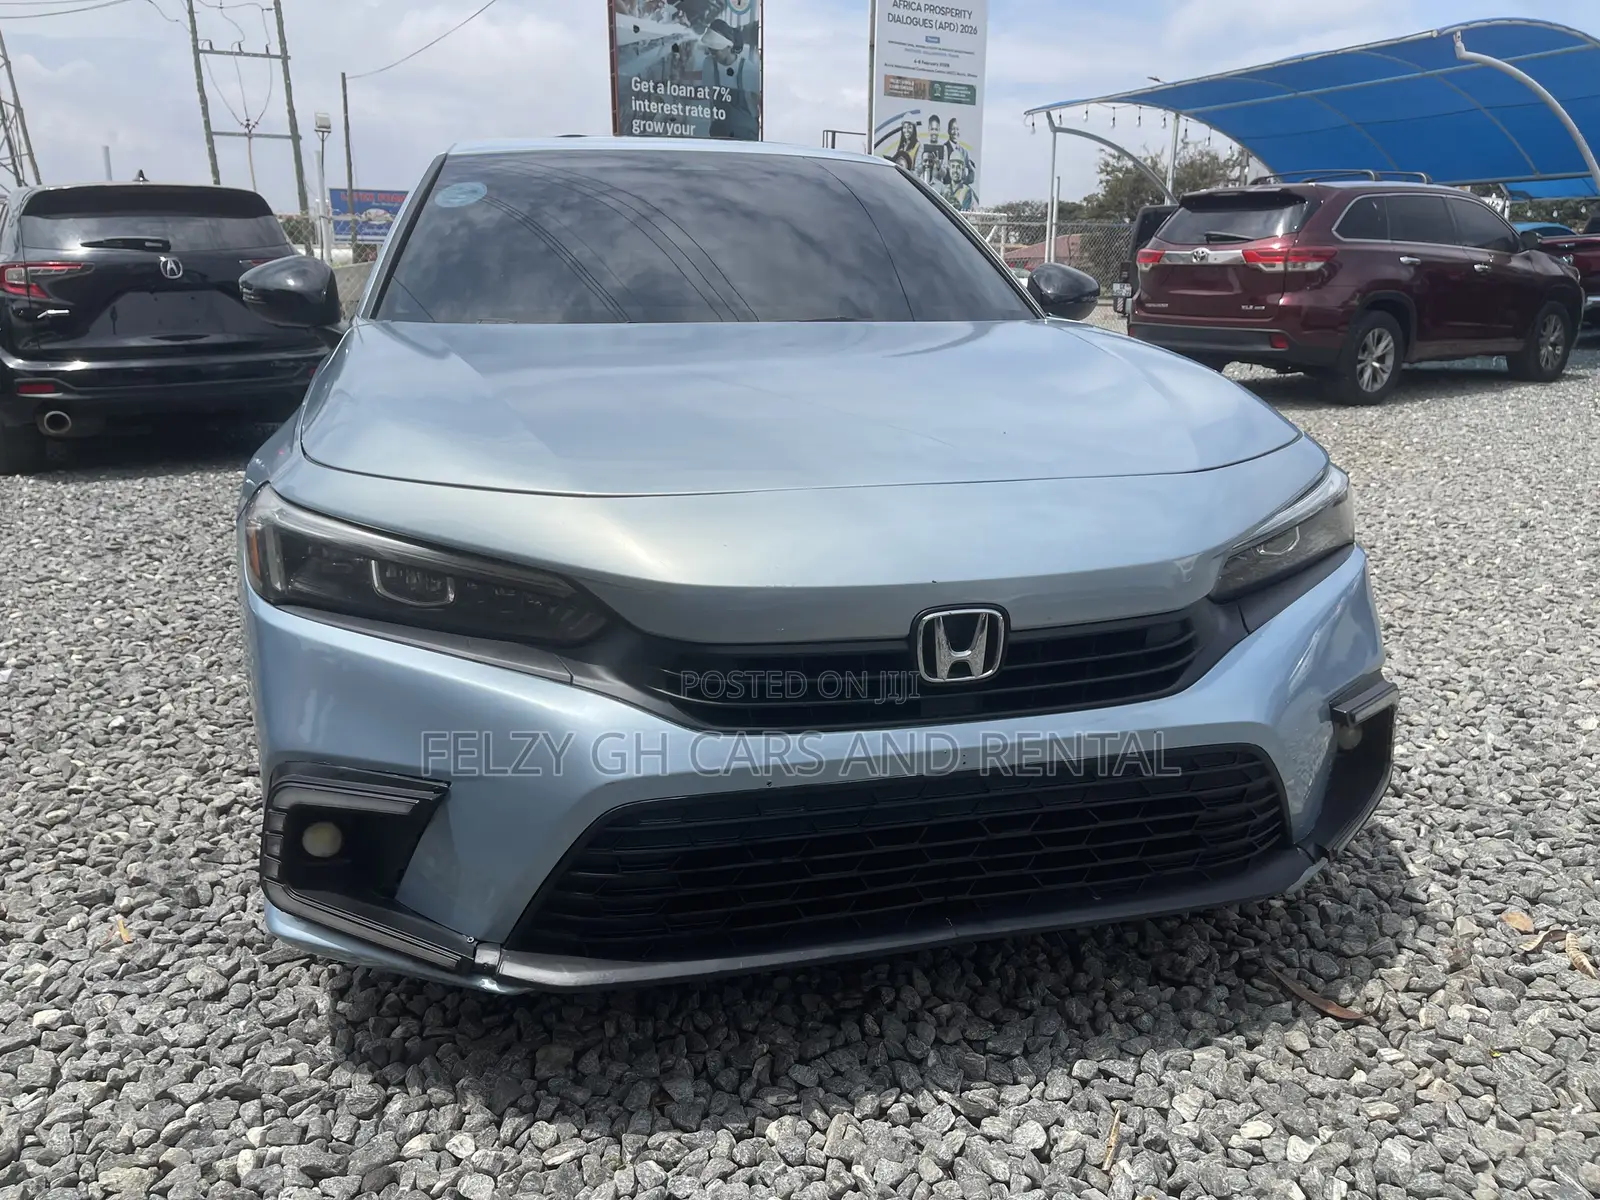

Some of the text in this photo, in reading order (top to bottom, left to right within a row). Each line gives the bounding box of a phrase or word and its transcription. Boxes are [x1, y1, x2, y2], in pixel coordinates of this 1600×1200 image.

[892, 0, 973, 20] AFRICA PROSPERITY
[887, 12, 978, 35] DIALOGUES (APD) 2026
[631, 76, 732, 102] Get a loan at 7%
[631, 96, 726, 120] interest rate to
[631, 118, 696, 136] grow your
